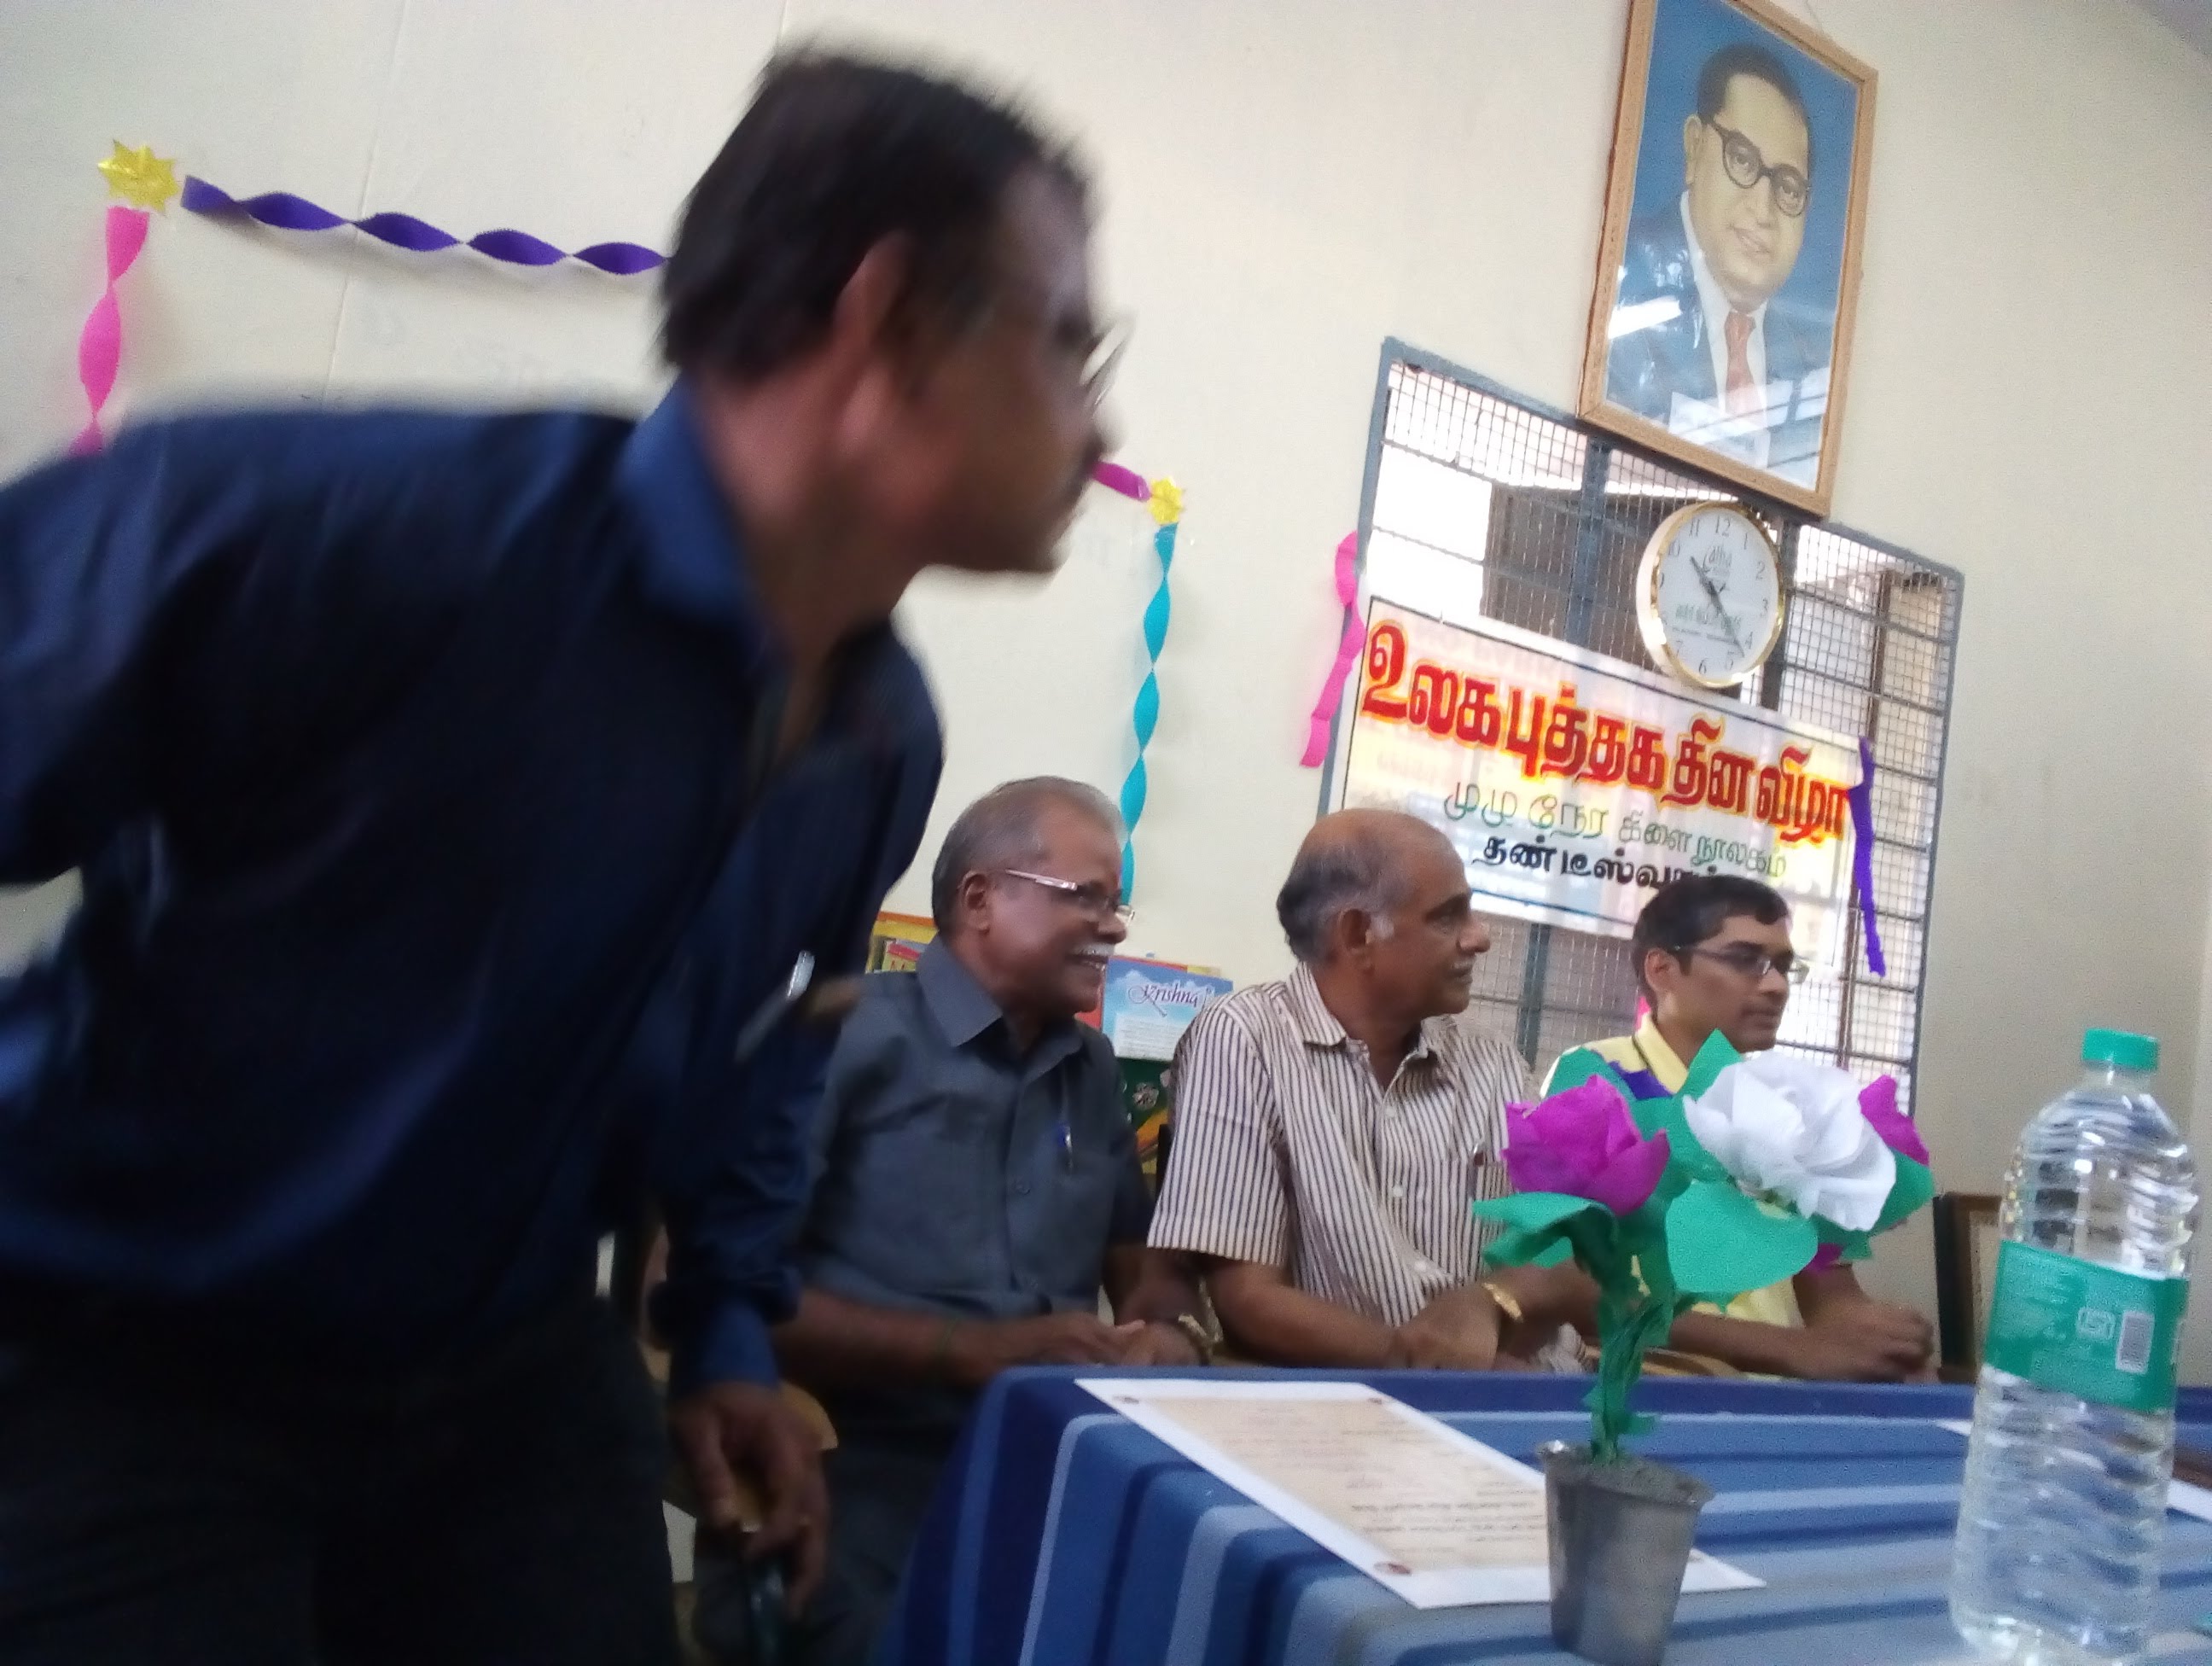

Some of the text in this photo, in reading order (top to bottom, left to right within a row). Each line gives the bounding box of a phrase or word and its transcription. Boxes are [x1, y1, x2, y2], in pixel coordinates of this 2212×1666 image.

[1715, 515, 1732, 538] 12
[1528, 794, 1610, 839] நேர
[1128, 982, 1198, 1017] Krishna
